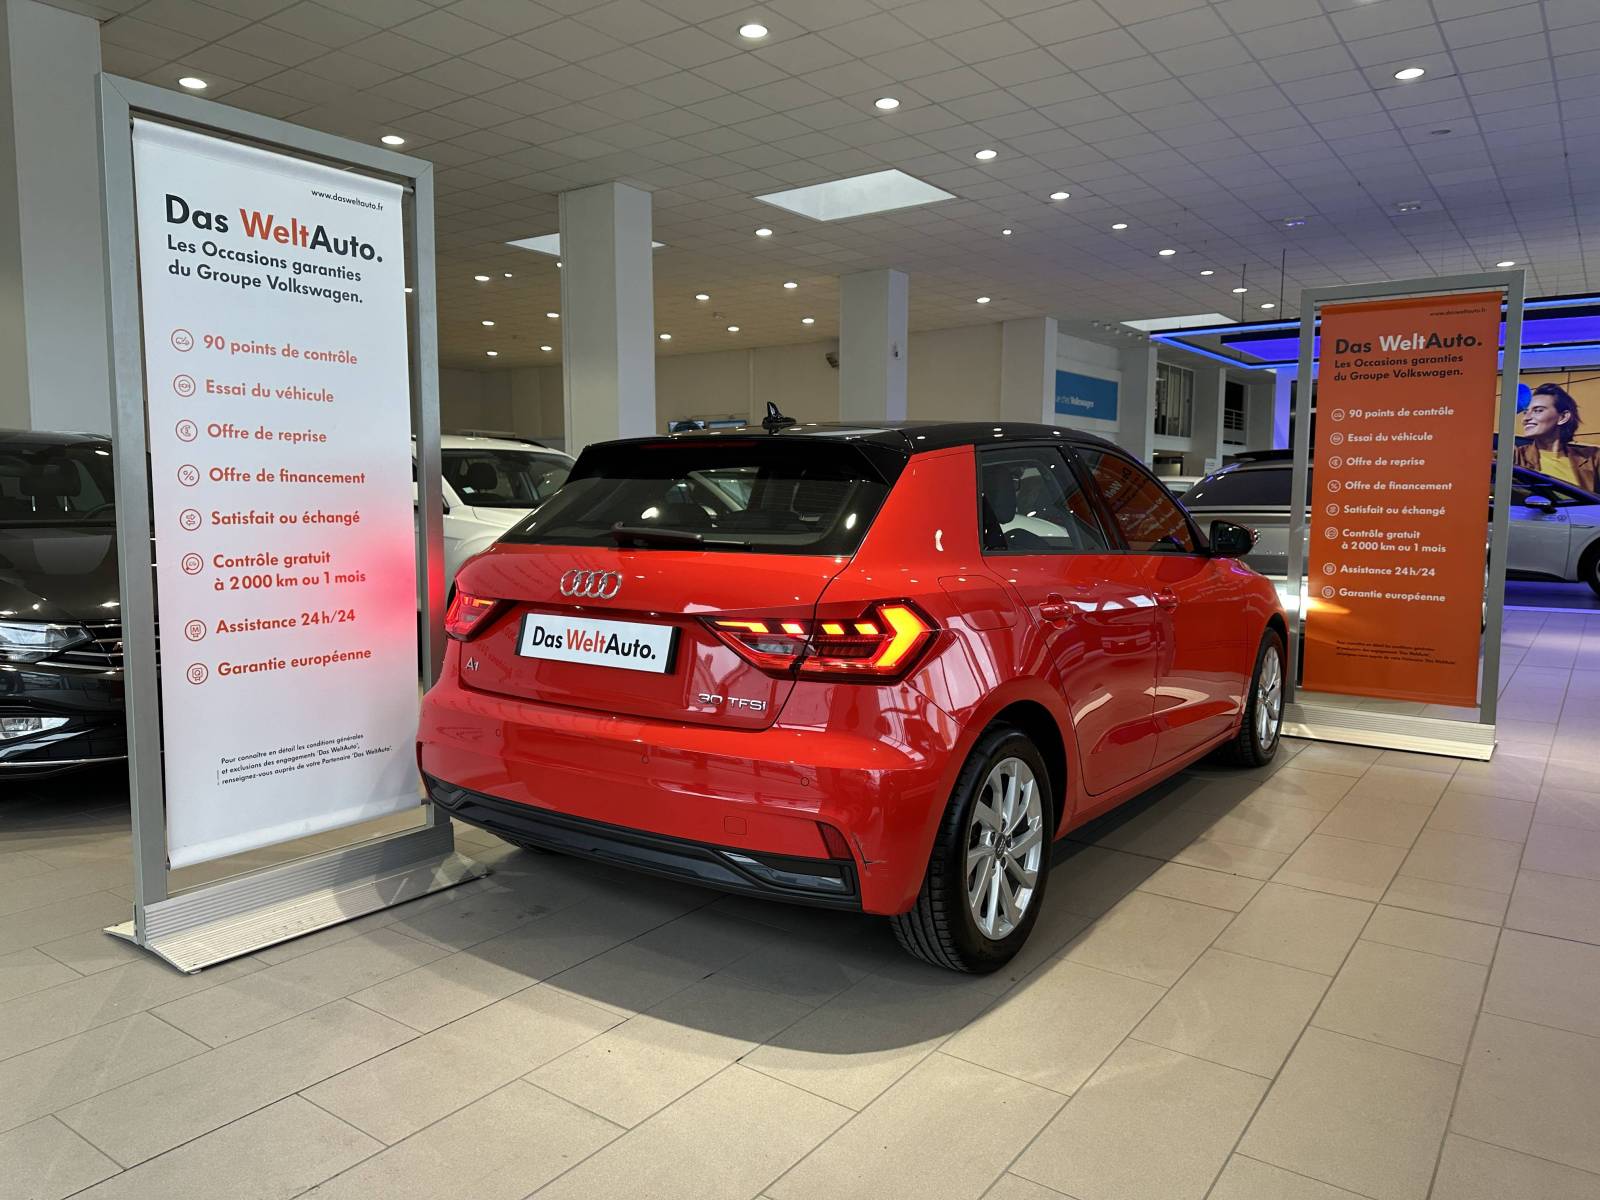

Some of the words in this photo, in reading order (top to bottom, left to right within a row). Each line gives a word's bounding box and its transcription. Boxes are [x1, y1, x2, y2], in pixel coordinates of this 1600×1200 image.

[311, 189, 383, 211] www.dasweltauto.fr
[165, 193, 229, 233] Das
[240, 208, 383, 262] WeltAuto.
[167, 234, 196, 253] Les
[202, 241, 287, 269] Occasions
[292, 261, 361, 281] garanties
[168, 259, 190, 276] du
[197, 264, 261, 288] Groupe
[267, 275, 363, 303] Volkswagen.
[203, 335, 225, 350] 90
[231, 341, 276, 355] points
[281, 344, 299, 358] de
[304, 349, 358, 364] contrôle
[1336, 339, 1372, 354] Das
[1379, 333, 1482, 351] WeltAuto.
[1335, 359, 1351, 369] Les
[1354, 357, 1408, 367] Occasions
[1412, 354, 1463, 365] garanties
[1334, 372, 1346, 381] du
[1350, 371, 1389, 381] Groupe
[1393, 368, 1463, 378] Volkswagen.
[206, 380, 246, 395] Essai
[252, 384, 270, 397] du
[275, 386, 334, 402] véhicule
[1349, 409, 1362, 418] 90
[1365, 409, 1394, 419] points
[1397, 408, 1410, 417] de
[1413, 406, 1454, 416] contrôle
[207, 424, 249, 439] Offre
[255, 426, 273, 440] de
[278, 428, 326, 444] reprise
[1348, 434, 1372, 442] Essai
[1376, 433, 1388, 442] du
[1392, 432, 1433, 441] véhicule
[1347, 457, 1372, 466] Offre
[1375, 457, 1387, 466] de
[1390, 458, 1425, 467] reprise
[209, 467, 251, 482] Offre
[256, 468, 274, 482] de
[280, 469, 365, 484] financement
[1345, 481, 1370, 490] Offre
[1374, 481, 1386, 490] de
[1389, 481, 1452, 490] financement
[212, 511, 274, 525] Satisfait
[279, 513, 297, 524] ou
[303, 510, 360, 526] échangé
[1344, 505, 1384, 514] Satisfait
[1402, 506, 1446, 516] échangé
[1343, 528, 1383, 538] Contrôle
[1387, 530, 1420, 540] gratuit
[1341, 541, 1348, 550] à
[1380, 542, 1395, 551] km
[1398, 544, 1411, 552] ou
[1414, 543, 1418, 552] 1
[1422, 544, 1446, 553] mois
[213, 552, 278, 568] Contrôle
[284, 552, 331, 568] gratuit
[1340, 565, 1392, 575] Assistance
[214, 578, 224, 591] à
[277, 574, 298, 587] km
[303, 575, 320, 585] ou
[324, 572, 329, 584] 1
[335, 570, 365, 583] mois
[1339, 588, 1382, 598] Garantie
[1385, 592, 1445, 602] européenne
[216, 618, 296, 634] Assistance
[533, 626, 563, 650] Das
[567, 628, 656, 660] WeltAuto.
[218, 658, 285, 676] Garantie
[291, 650, 371, 668] européenne
[464, 658, 479, 672] A1
[697, 693, 723, 705] 30
[727, 697, 766, 711] TFSI
[237, 750, 267, 762] connaître
[278, 745, 295, 754] détail
[307, 739, 335, 749] conditions
[336, 733, 363, 744] générales
[222, 770, 273, 784] renseignez-vous
[275, 766, 295, 774] auprès
[306, 760, 320, 768] votre
[322, 754, 351, 764] Partenaire
[230, 762, 261, 773] exclusions
[276, 752, 315, 764] engagements
